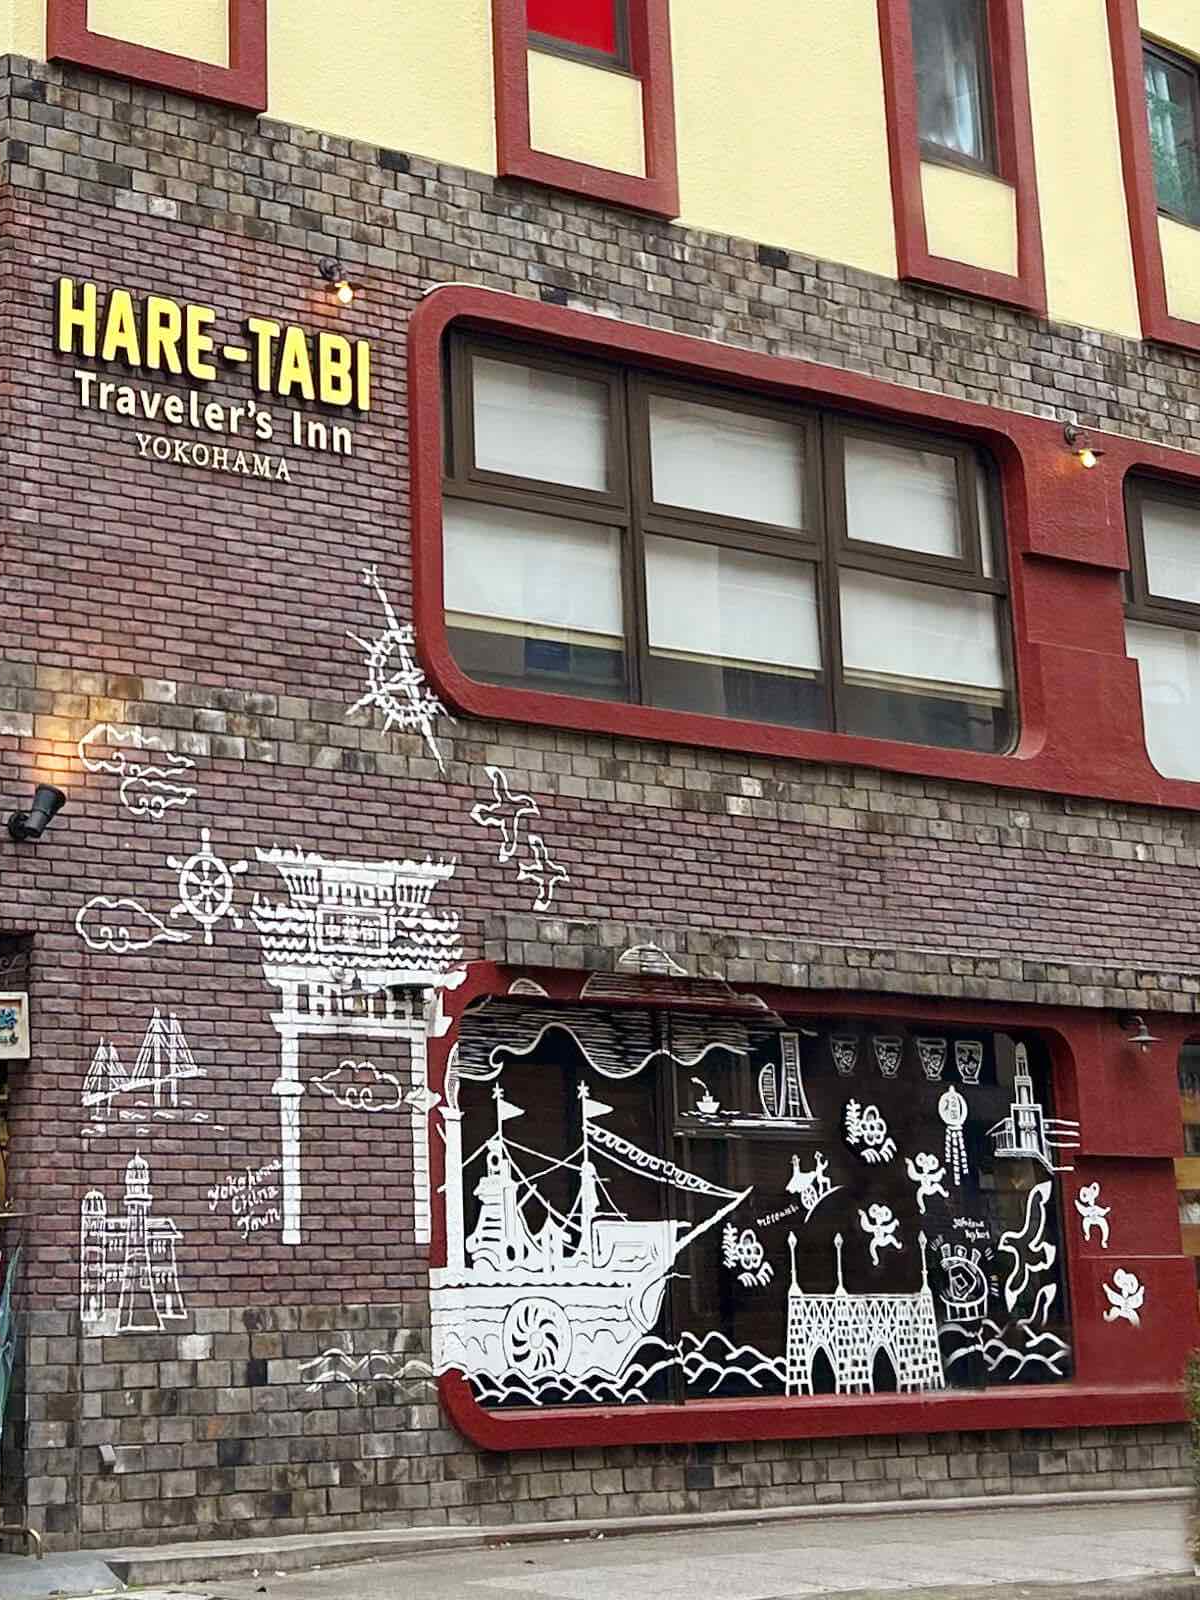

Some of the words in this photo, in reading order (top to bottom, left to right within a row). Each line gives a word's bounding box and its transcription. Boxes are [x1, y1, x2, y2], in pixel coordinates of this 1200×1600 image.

[57, 277, 371, 411] HARE-TABI
[135, 432, 292, 481] YOKOHAMA
[292, 411, 353, 455] Inn
